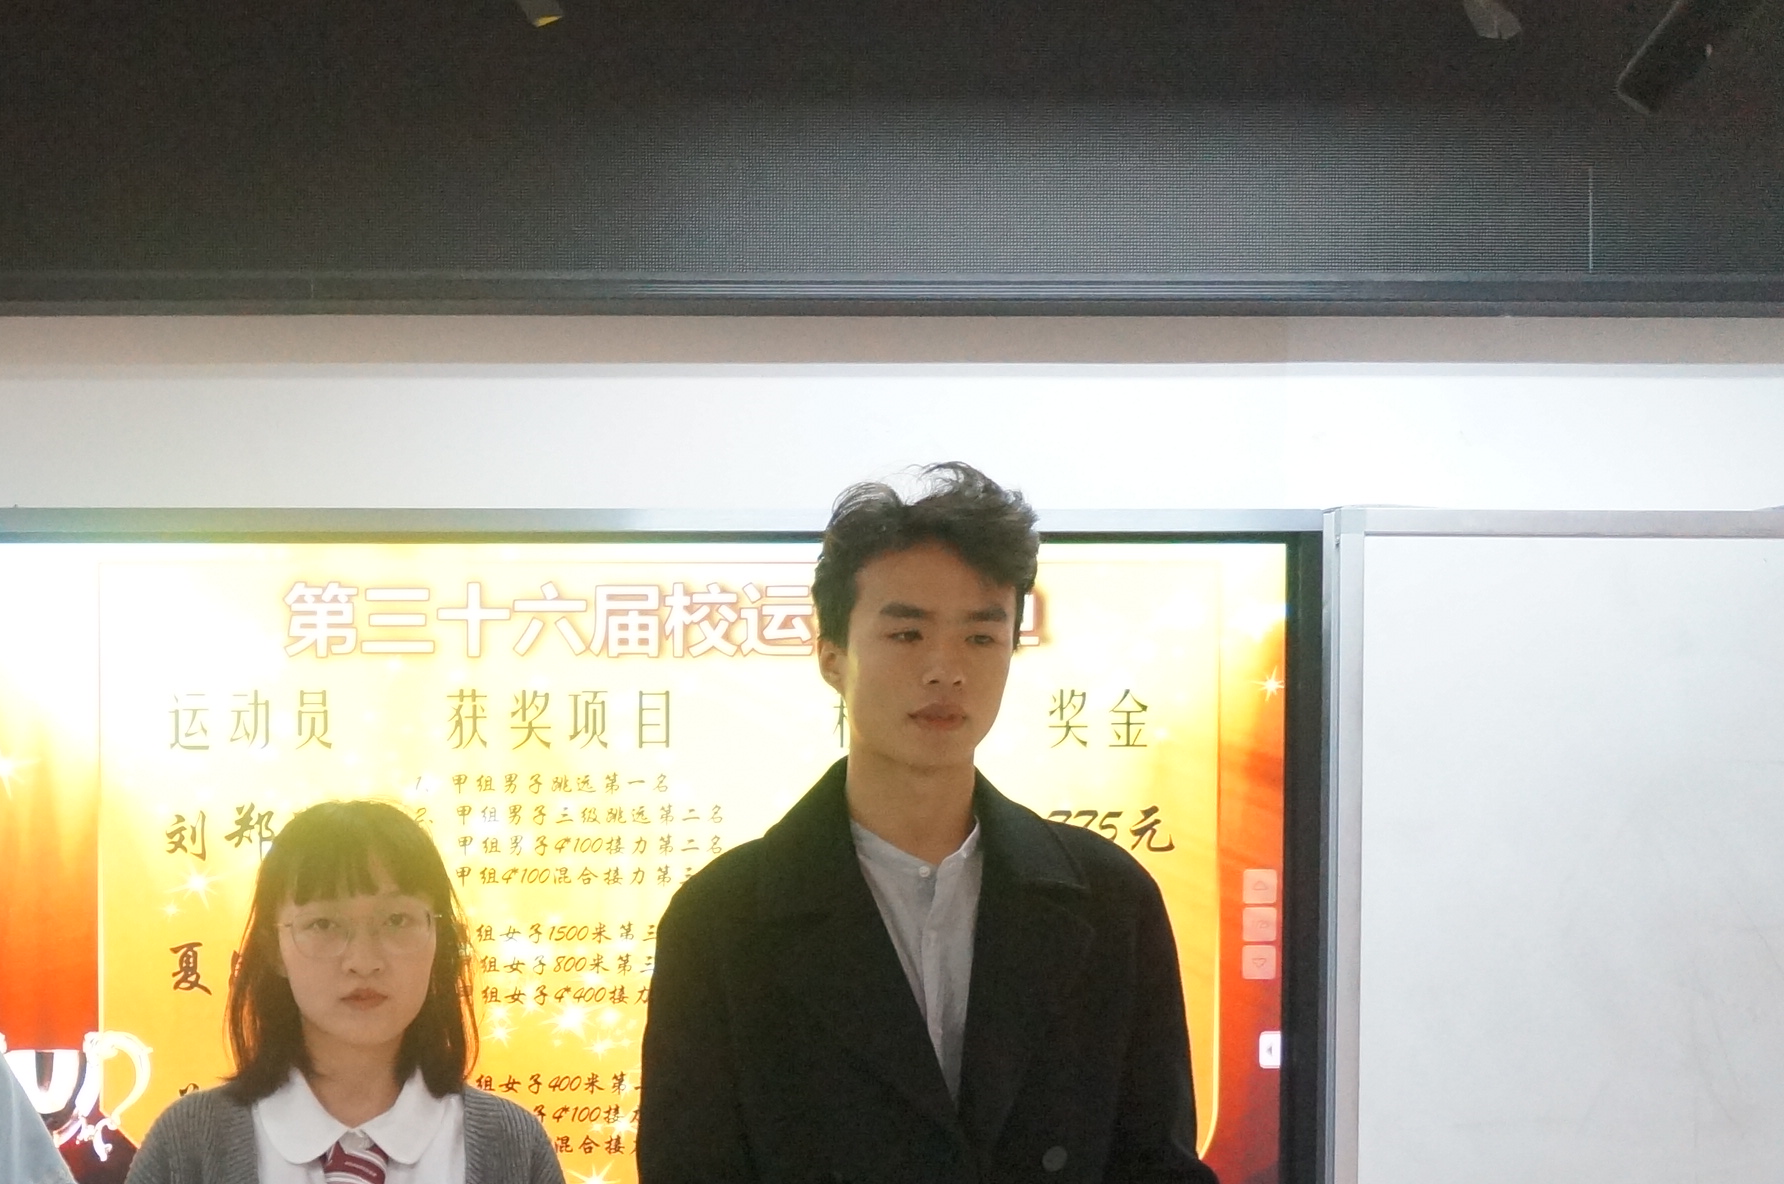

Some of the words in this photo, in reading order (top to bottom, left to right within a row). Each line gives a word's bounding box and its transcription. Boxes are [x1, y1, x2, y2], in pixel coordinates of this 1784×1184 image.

[282, 580, 1040, 659] 第三十六届校运
[169, 688, 335, 752] 运动员
[447, 687, 673, 751] 获奖项目
[1048, 687, 1150, 750] 奖金
[451, 772, 669, 794] 甲组男子跳远第一名
[456, 803, 724, 826] 甲组男子三级跳远第二名
[458, 920, 658, 944] 组女子1500米第三
[463, 952, 656, 976] 组女子800米第三
[463, 984, 650, 1006] 组女子4400接力
[466, 1071, 643, 1096] 组女子400米第
[555, 1135, 640, 1155] 混合接
